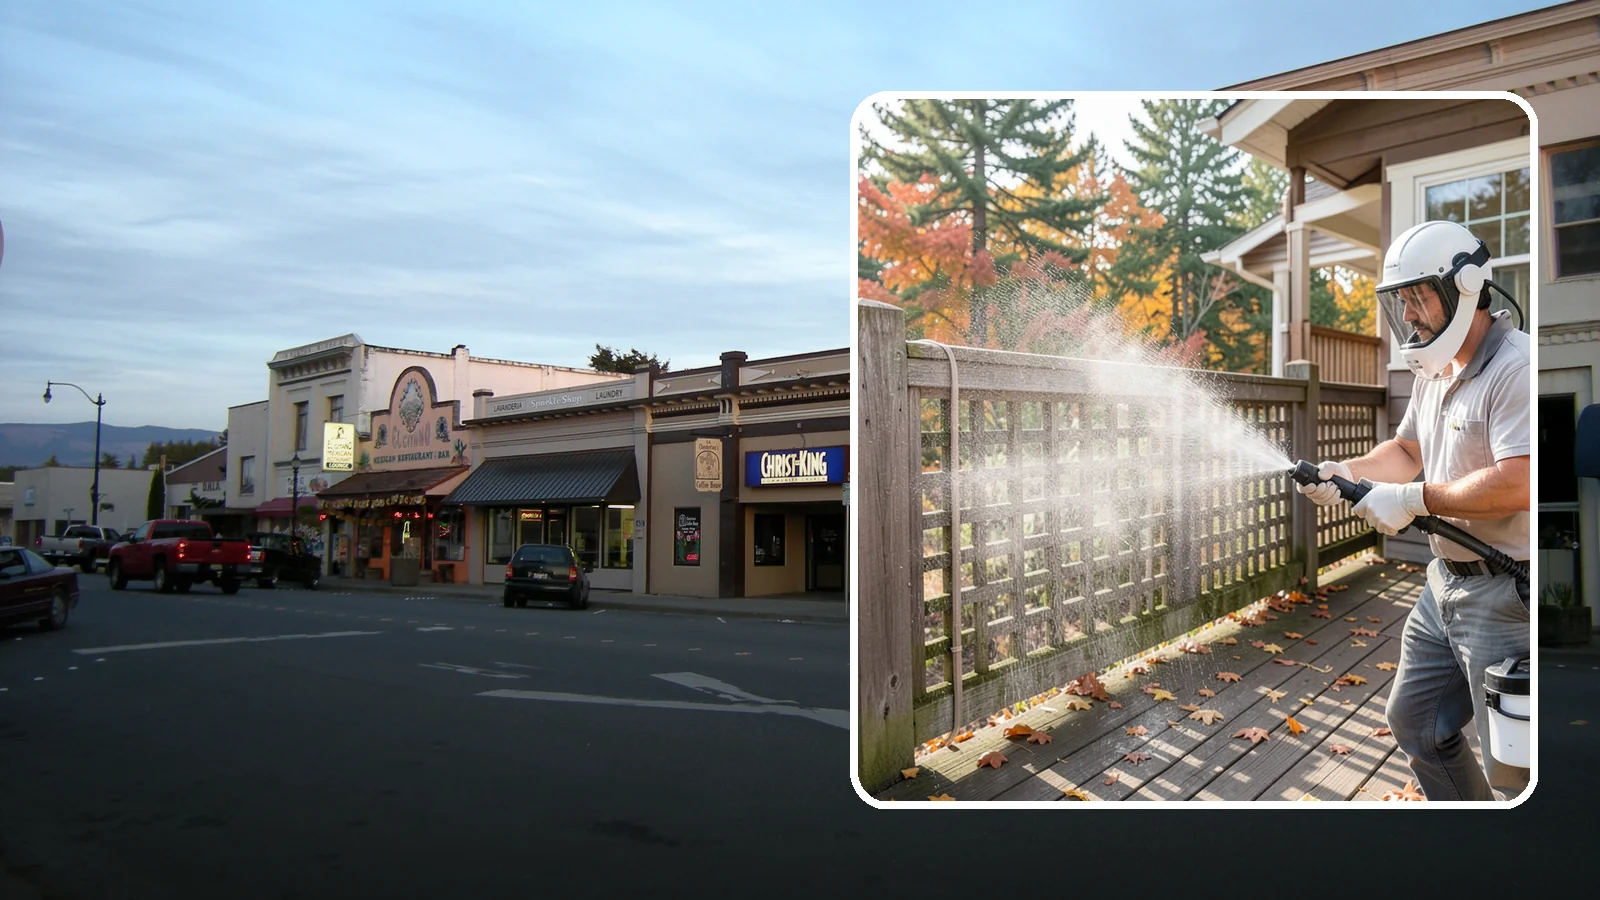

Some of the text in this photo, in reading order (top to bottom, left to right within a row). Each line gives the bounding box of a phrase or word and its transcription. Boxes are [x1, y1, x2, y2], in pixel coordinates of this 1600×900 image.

[562, 394, 582, 405] Shop
[595, 389, 623, 399] LAUNDRY
[493, 402, 522, 412] LAVANDERIA
[373, 450, 450, 464] MEXICAN RESTAURANT BAR
[761, 450, 827, 478] CHRIST KING
